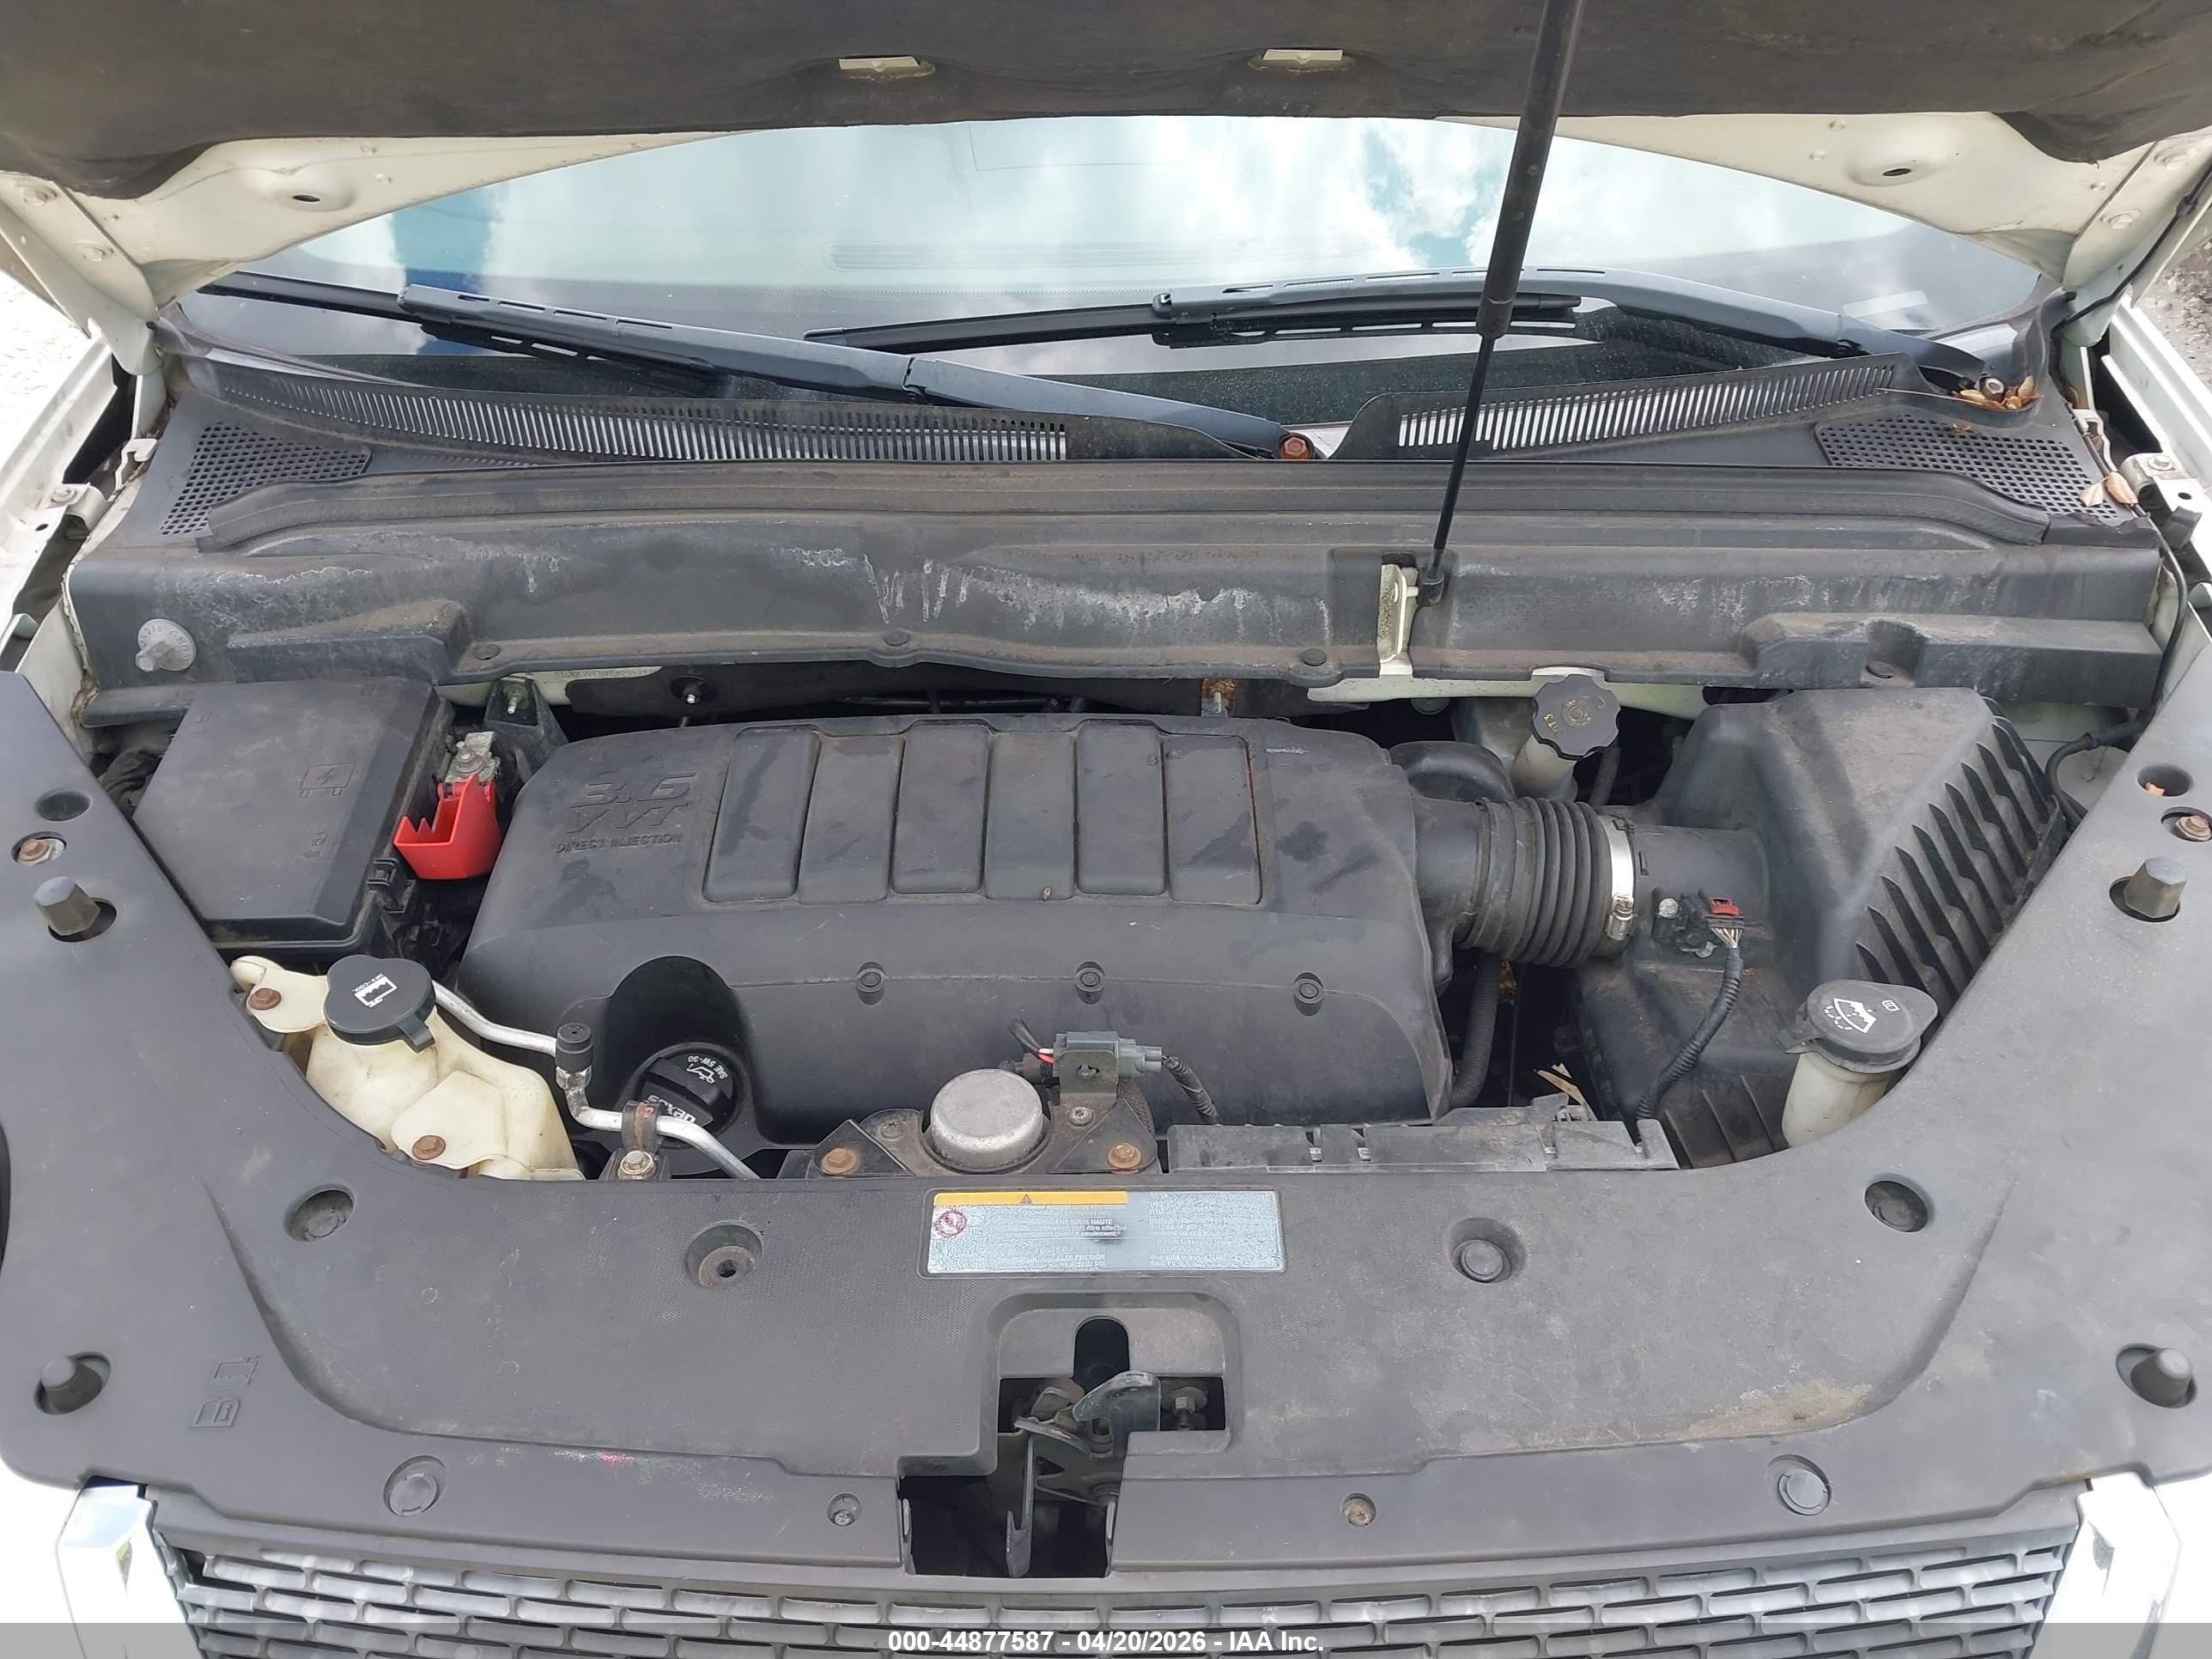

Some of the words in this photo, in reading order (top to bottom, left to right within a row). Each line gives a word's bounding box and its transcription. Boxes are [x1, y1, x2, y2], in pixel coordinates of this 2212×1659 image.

[569, 770, 697, 809] 3.6
[566, 803, 690, 834] VVT
[555, 838, 606, 854] DIRECT
[610, 832, 684, 848] INJECTION
[688, 1055, 716, 1067] 5W-30
[714, 1066, 728, 1079] SAE
